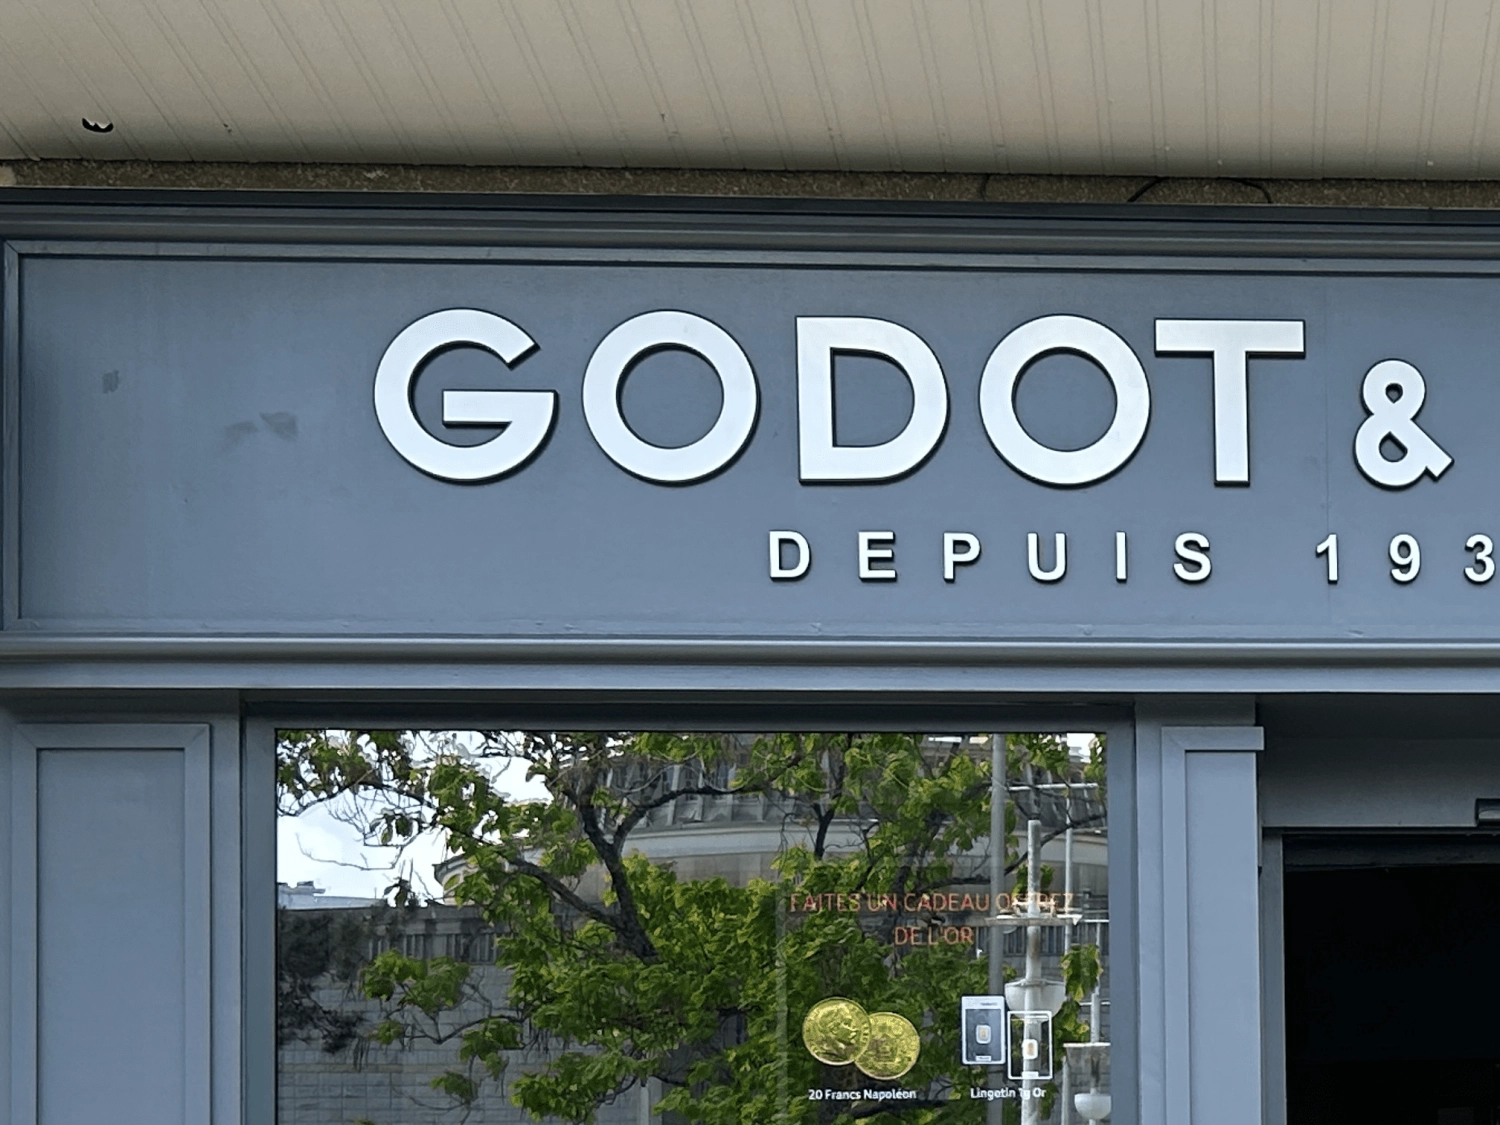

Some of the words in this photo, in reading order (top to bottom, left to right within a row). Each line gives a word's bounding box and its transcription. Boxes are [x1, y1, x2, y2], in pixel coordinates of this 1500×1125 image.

[374, 308, 1306, 489] GODOT
[1354, 359, 1454, 490] &
[769, 530, 1212, 584] DEPUIS
[867, 893, 897, 911] UN
[904, 893, 989, 912] CADEAU
[895, 927, 919, 945] DE
[808, 1089, 823, 1100] 20
[825, 1089, 861, 1100] Francs
[1032, 1087, 1047, 1098] Or
